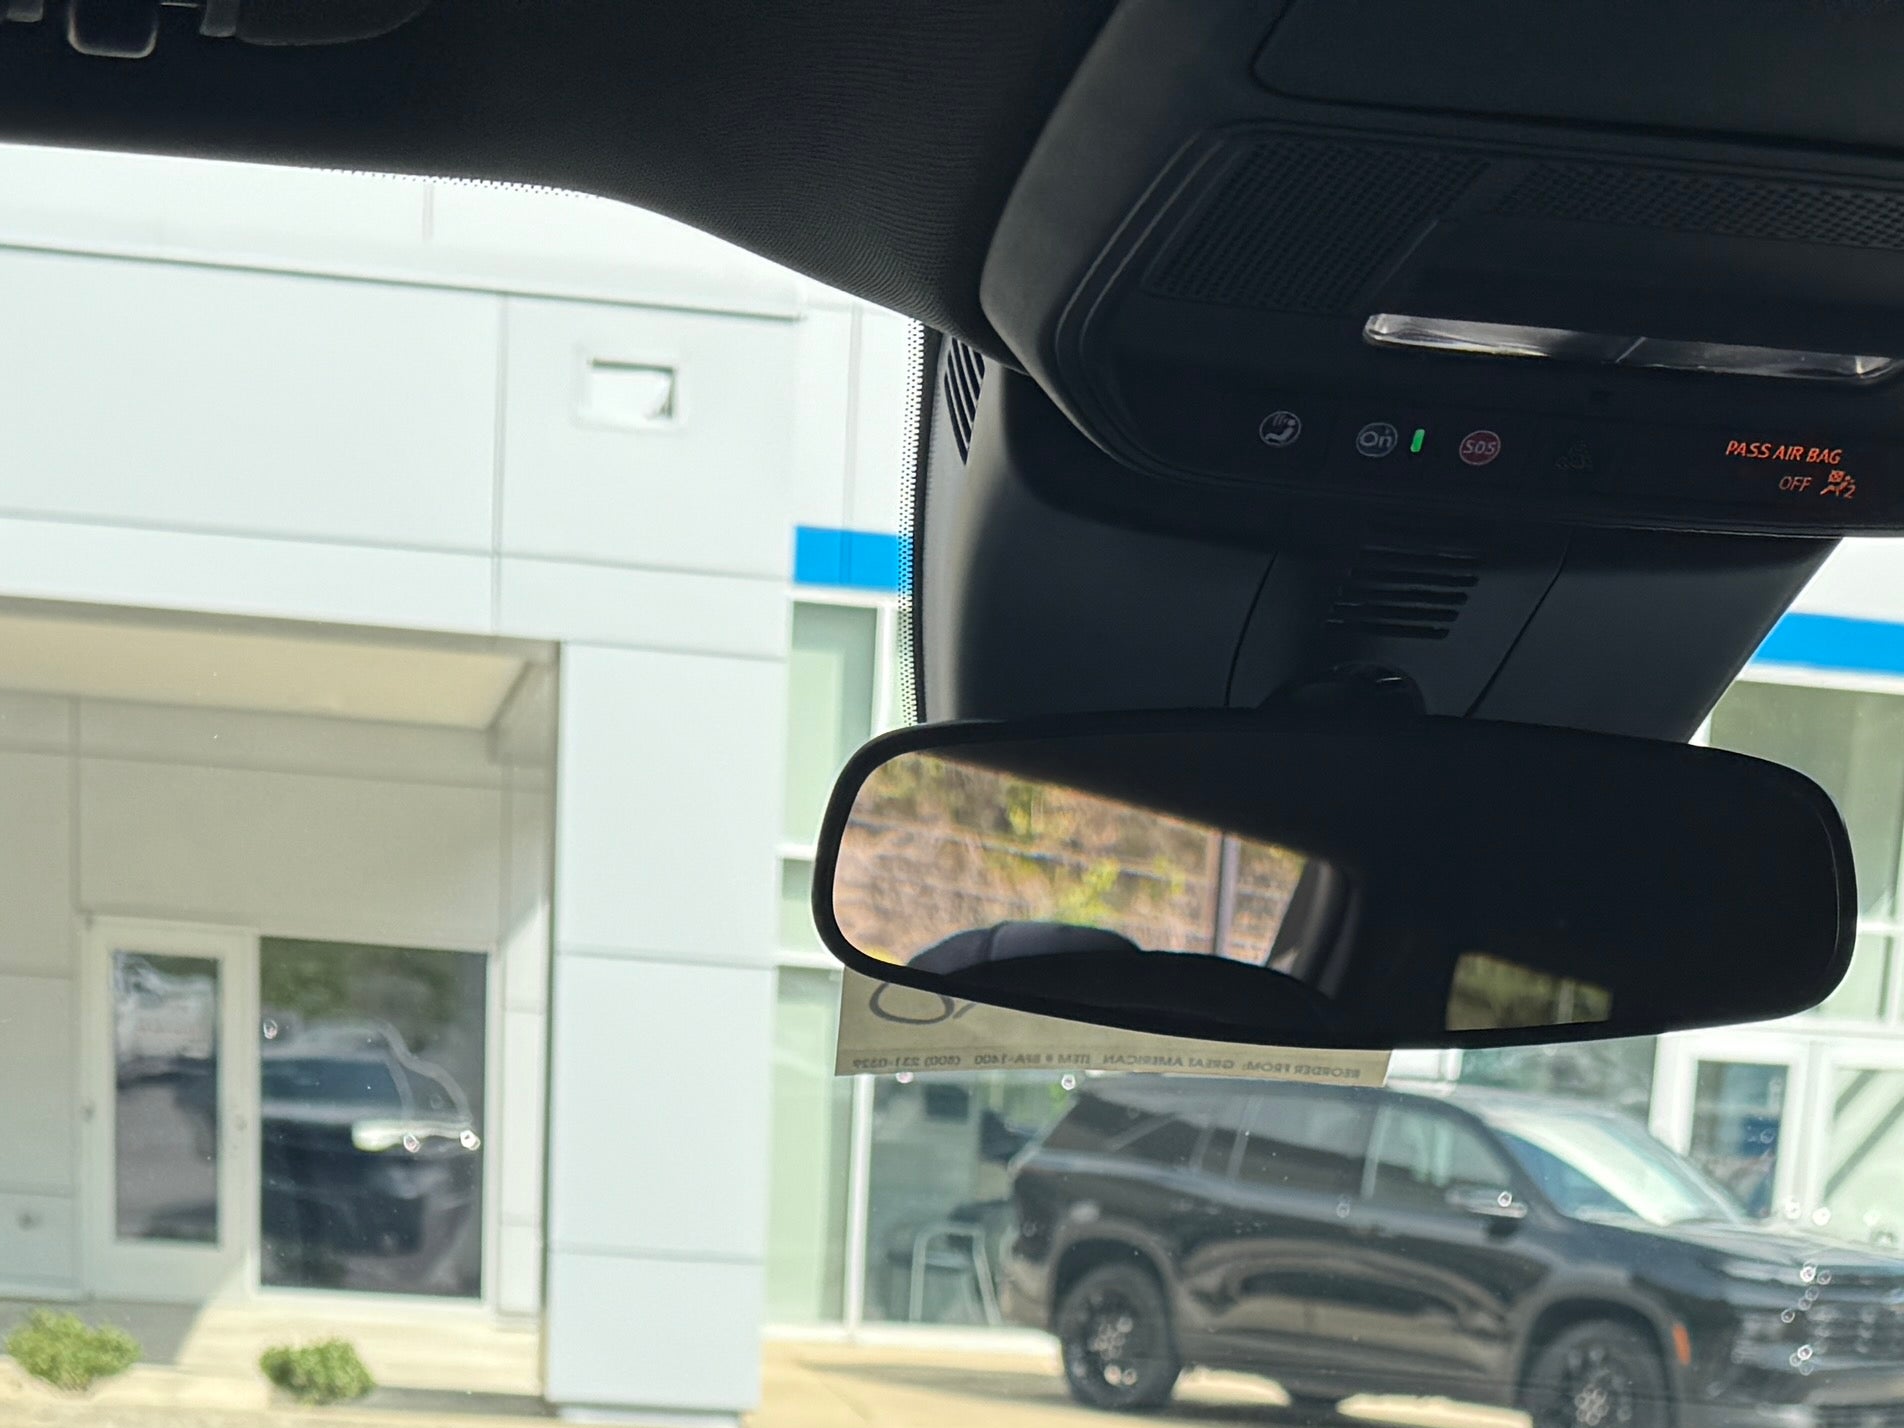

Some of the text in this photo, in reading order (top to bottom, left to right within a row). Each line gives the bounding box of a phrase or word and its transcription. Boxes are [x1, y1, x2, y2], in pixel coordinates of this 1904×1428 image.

[1462, 440, 1497, 455] SOS
[1725, 440, 1843, 465] PASS AIR BAG
[1779, 475, 1813, 492] OFF
